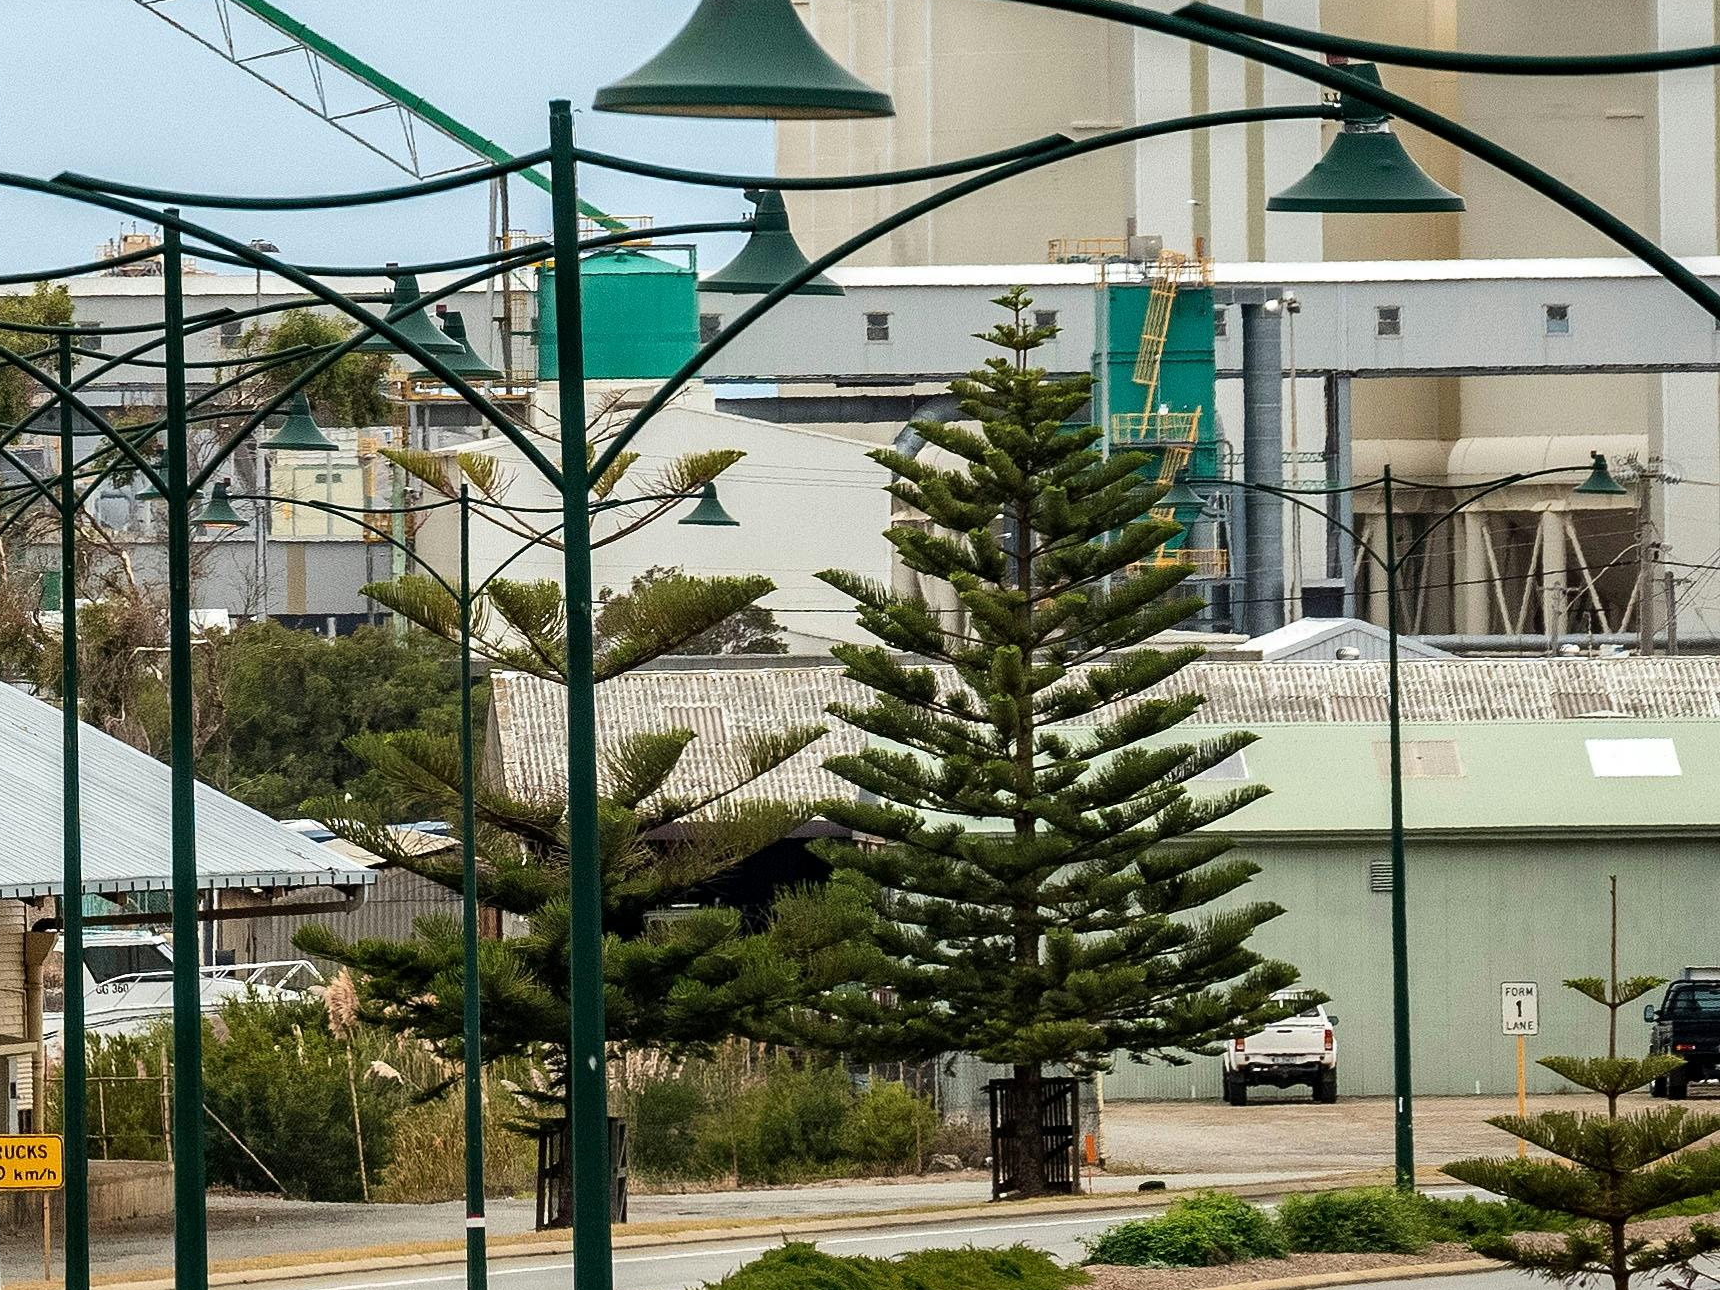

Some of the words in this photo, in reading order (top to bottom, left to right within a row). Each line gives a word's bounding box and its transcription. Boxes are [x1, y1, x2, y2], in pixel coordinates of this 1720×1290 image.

[1505, 987, 1533, 997] FORM
[1516, 1000, 1522, 1017] 1
[1506, 1021, 1534, 1030] LANE
[14, 1167, 56, 1180] km/h
